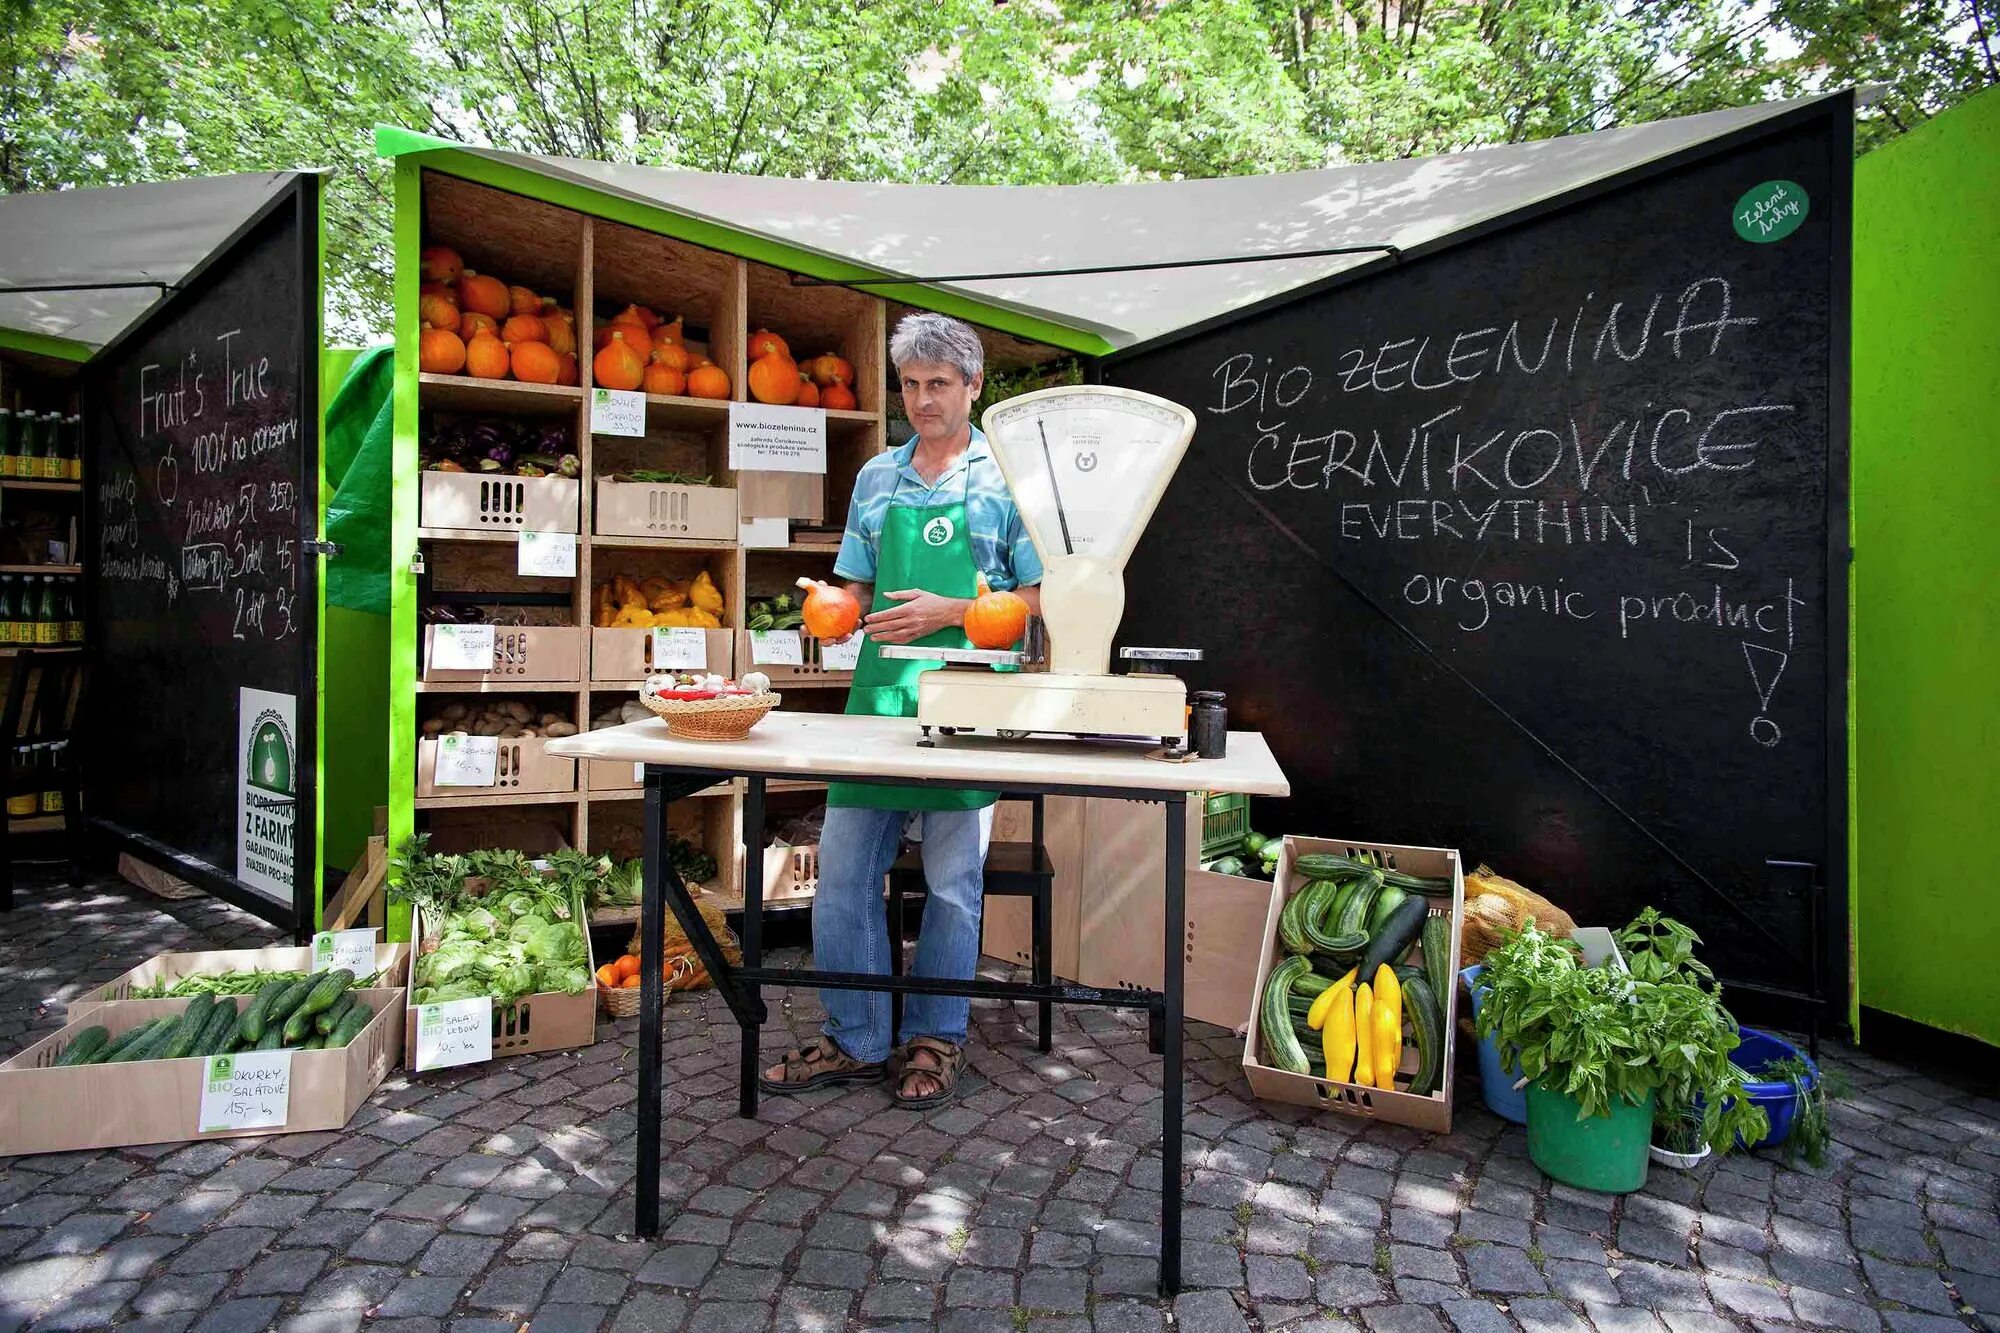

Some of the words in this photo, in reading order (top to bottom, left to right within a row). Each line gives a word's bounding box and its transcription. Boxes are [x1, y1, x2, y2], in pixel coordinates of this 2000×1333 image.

[217, 328, 269, 407] True
[735, 421, 818, 434] www.biozelenina.cz
[232, 433, 247, 461] no
[1403, 574, 1597, 632] organic
[1620, 577, 1805, 651] product
[245, 811, 252, 834] Z
[255, 814, 295, 850] FARMY
[245, 840, 294, 869] GARANTOVÁNO
[245, 857, 268, 876] SVAZEM
[269, 865, 294, 887] PRO-BIO
[316, 953, 334, 963] BIO
[422, 1025, 444, 1038] BIO
[234, 1068, 282, 1081] OKURKY
[208, 1081, 233, 1094] BIO
[232, 1077, 287, 1097] SALÁTOVÉ
[223, 1101, 255, 1118] 15,-
